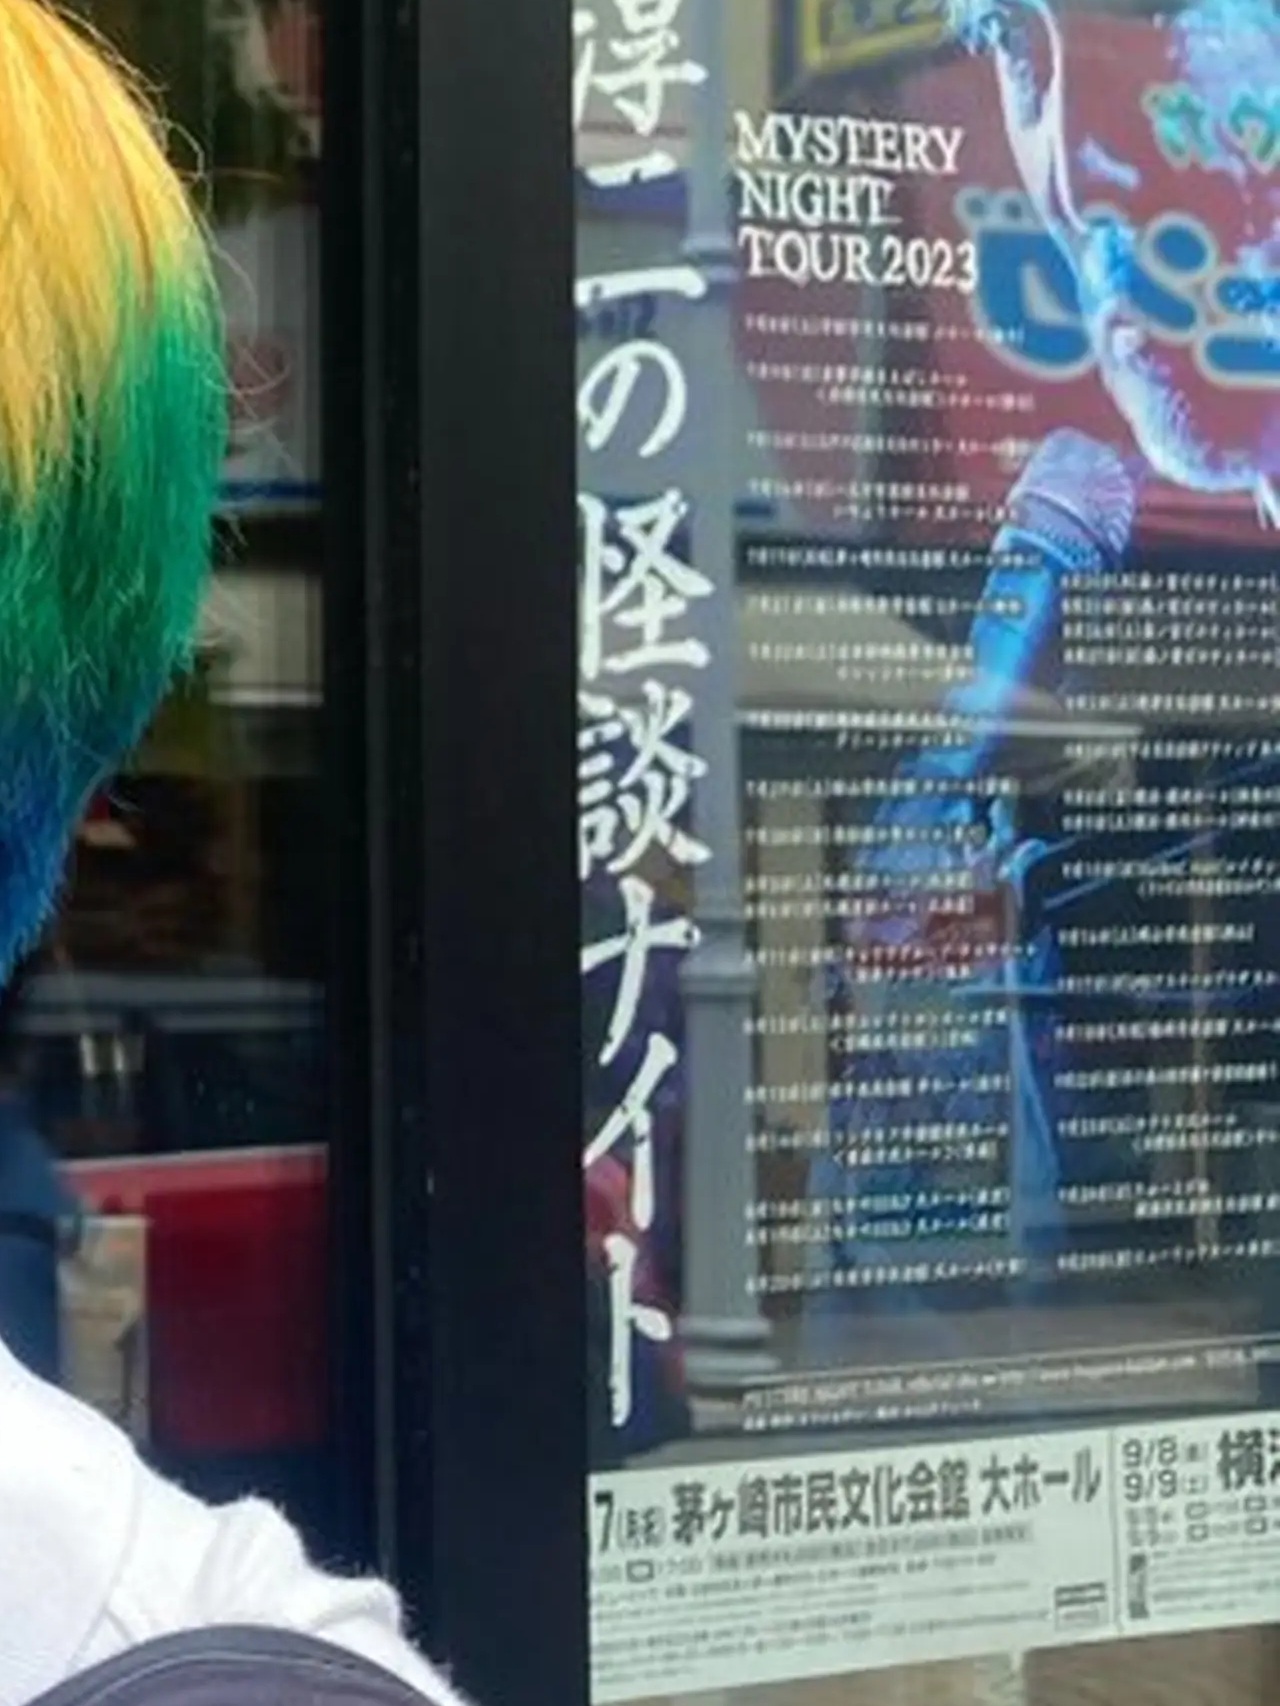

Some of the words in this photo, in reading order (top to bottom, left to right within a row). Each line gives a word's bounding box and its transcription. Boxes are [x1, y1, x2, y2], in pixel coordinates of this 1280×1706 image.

[734, 111, 964, 176] MYSTERY
[735, 167, 903, 228] NIGHT
[738, 225, 881, 287] TOUR
[881, 234, 979, 294] 2023
[980, 1444, 1103, 1515] 大ホール
